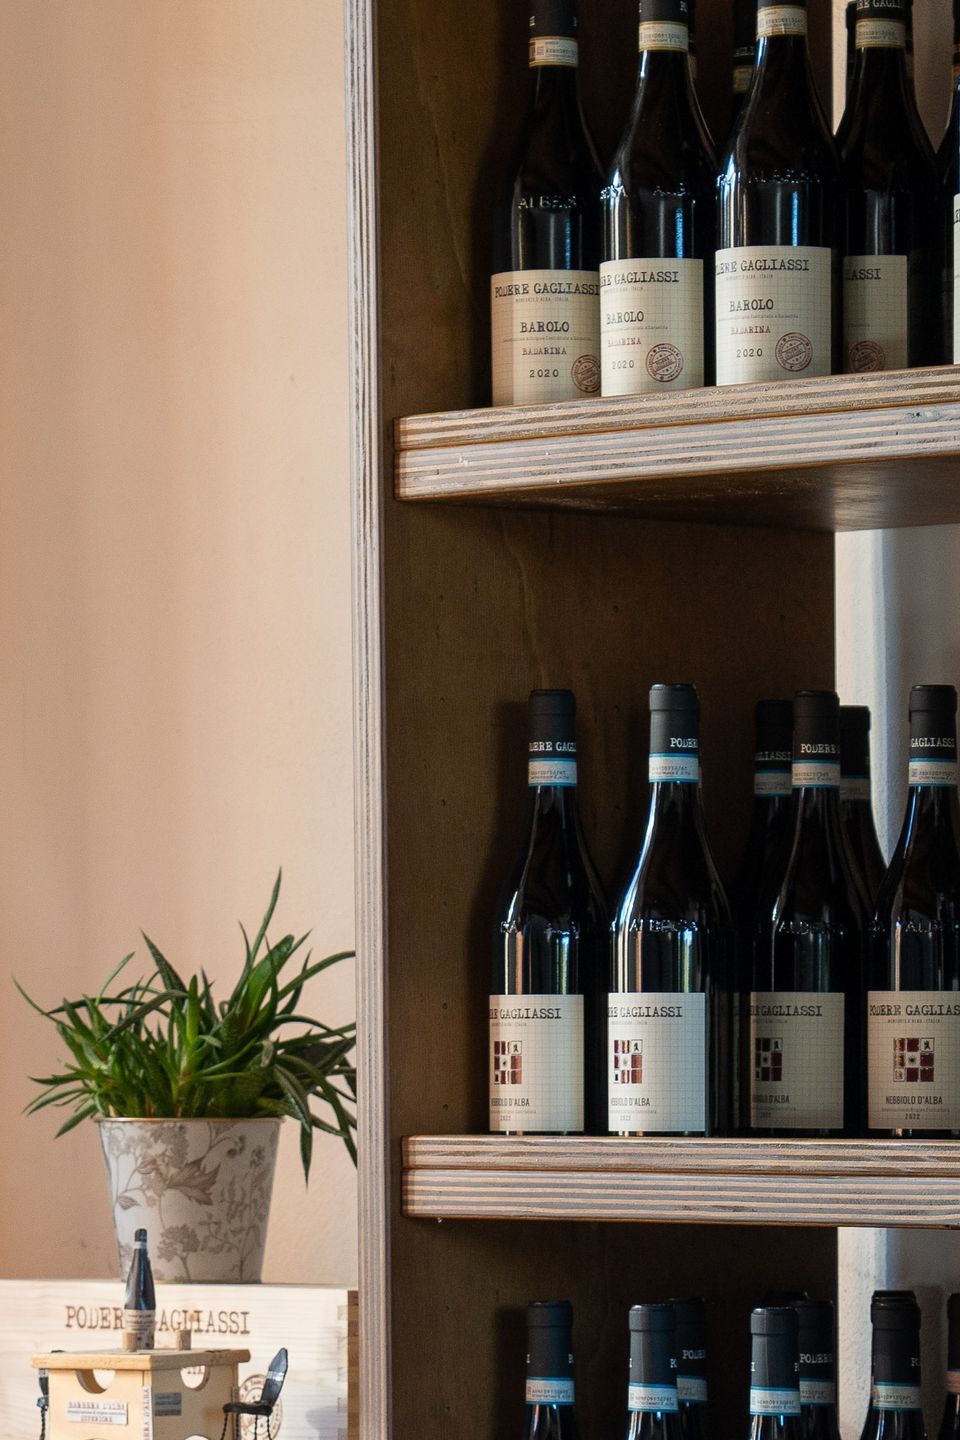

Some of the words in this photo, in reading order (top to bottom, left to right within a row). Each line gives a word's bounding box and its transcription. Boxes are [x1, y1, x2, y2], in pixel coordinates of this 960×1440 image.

[740, 258, 810, 272] GAGLIASSI
[614, 271, 679, 284] GAGLIASSI
[533, 282, 600, 296] GAGLIASSI
[729, 298, 774, 312] BAROLO
[606, 310, 645, 325] BAROLO
[520, 321, 570, 333] BAROLO
[521, 346, 568, 356] BADARINA
[736, 347, 763, 358] 2020
[611, 360, 635, 369] 2020
[529, 369, 559, 378] 2020
[500, 1007, 562, 1019] GAGLIASSI
[620, 1006, 683, 1018] GAGLIASSI
[760, 1005, 823, 1017] GAGLIASSI
[508, 1098, 530, 1107] D'ALBA
[629, 1098, 650, 1107] D'ALBA
[885, 1095, 916, 1105] NEBBIOLO
[917, 1095, 943, 1105] D'ALBA
[65, 1305, 125, 1330] PODER
[155, 1309, 251, 1335] AGLIASSI
